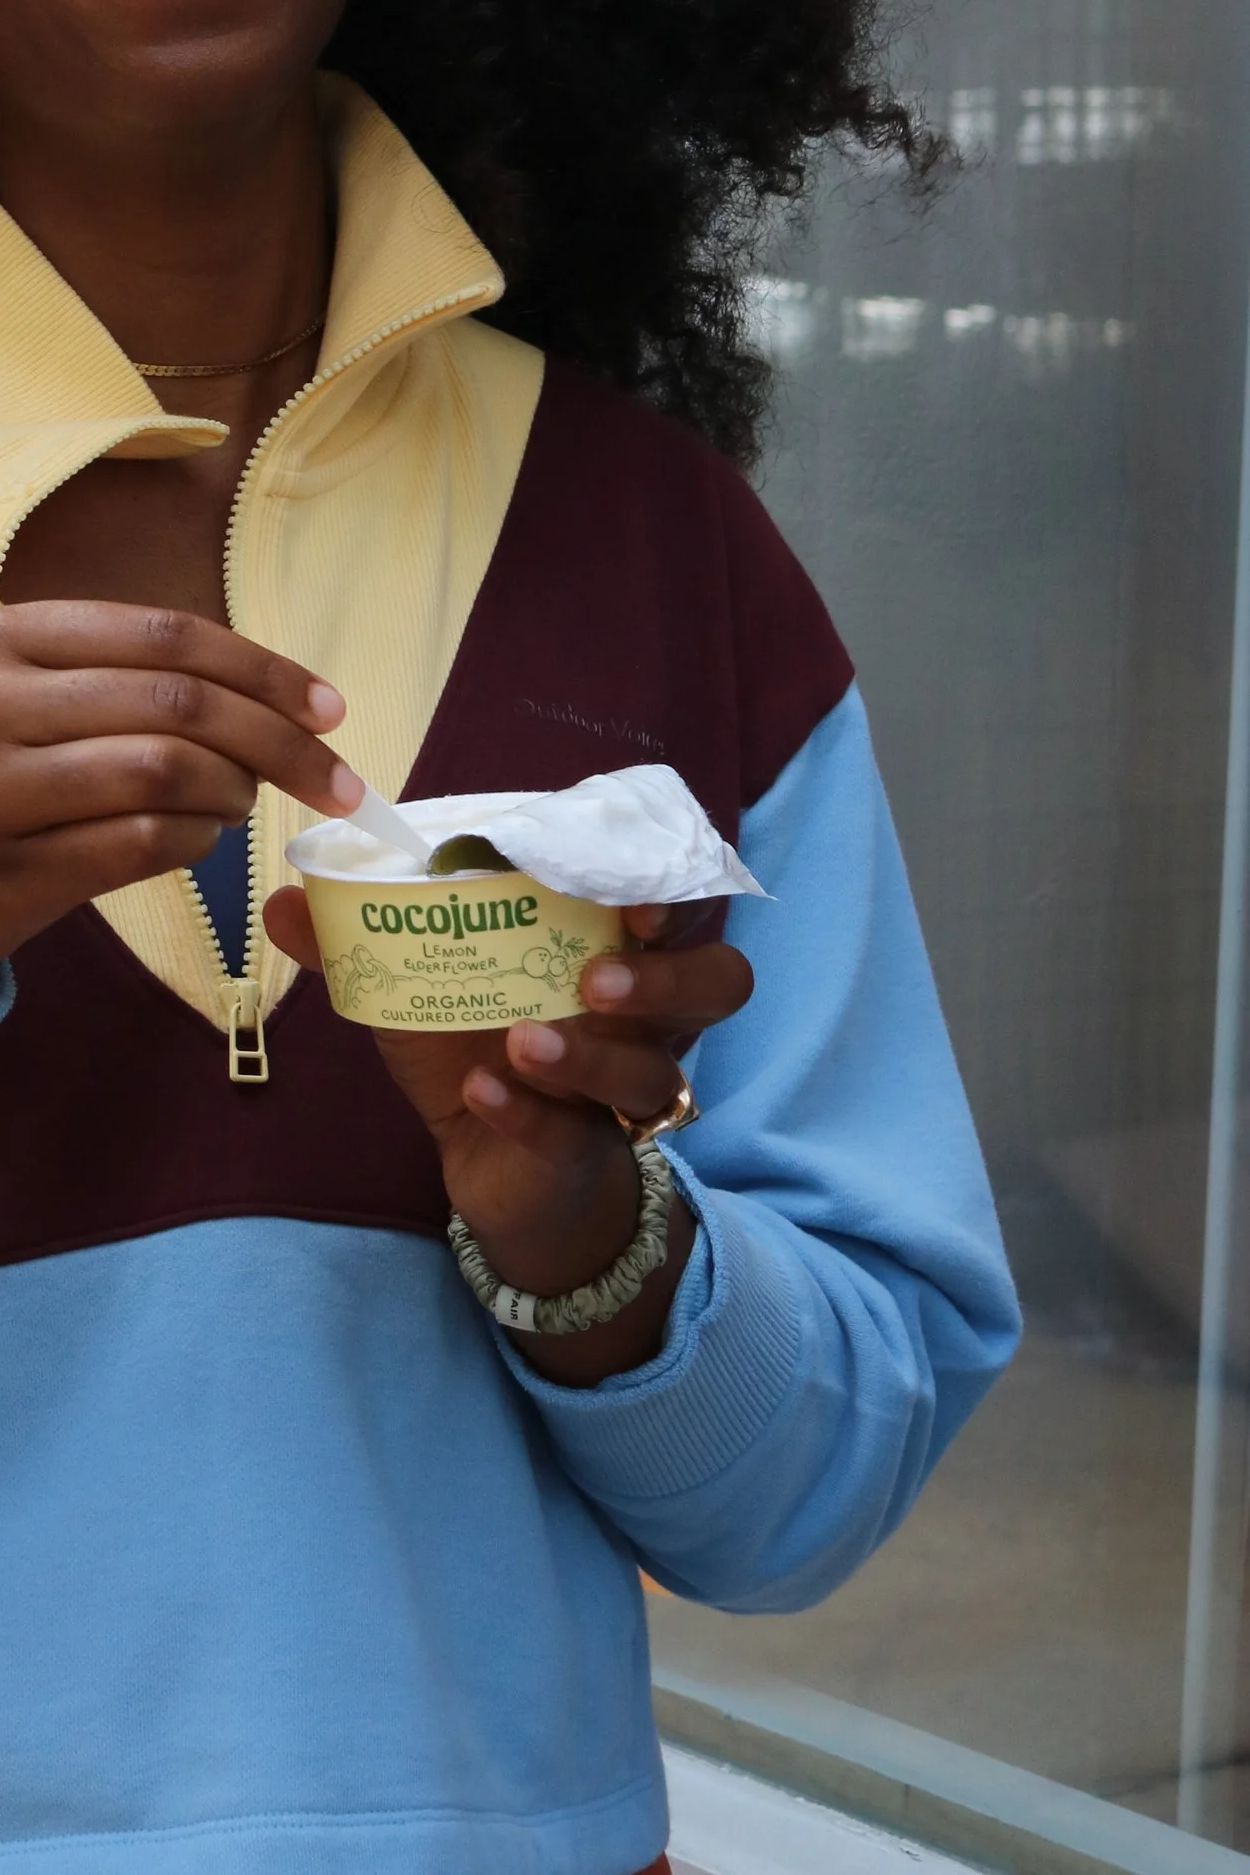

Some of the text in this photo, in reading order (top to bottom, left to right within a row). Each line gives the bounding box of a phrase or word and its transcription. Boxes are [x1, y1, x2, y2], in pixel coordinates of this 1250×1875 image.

[361, 893, 538, 940] cocojune
[422, 942, 477, 959] LEMON
[410, 992, 507, 1010] ORGANIC
[381, 1003, 543, 1023] CULTURED COCONUT
